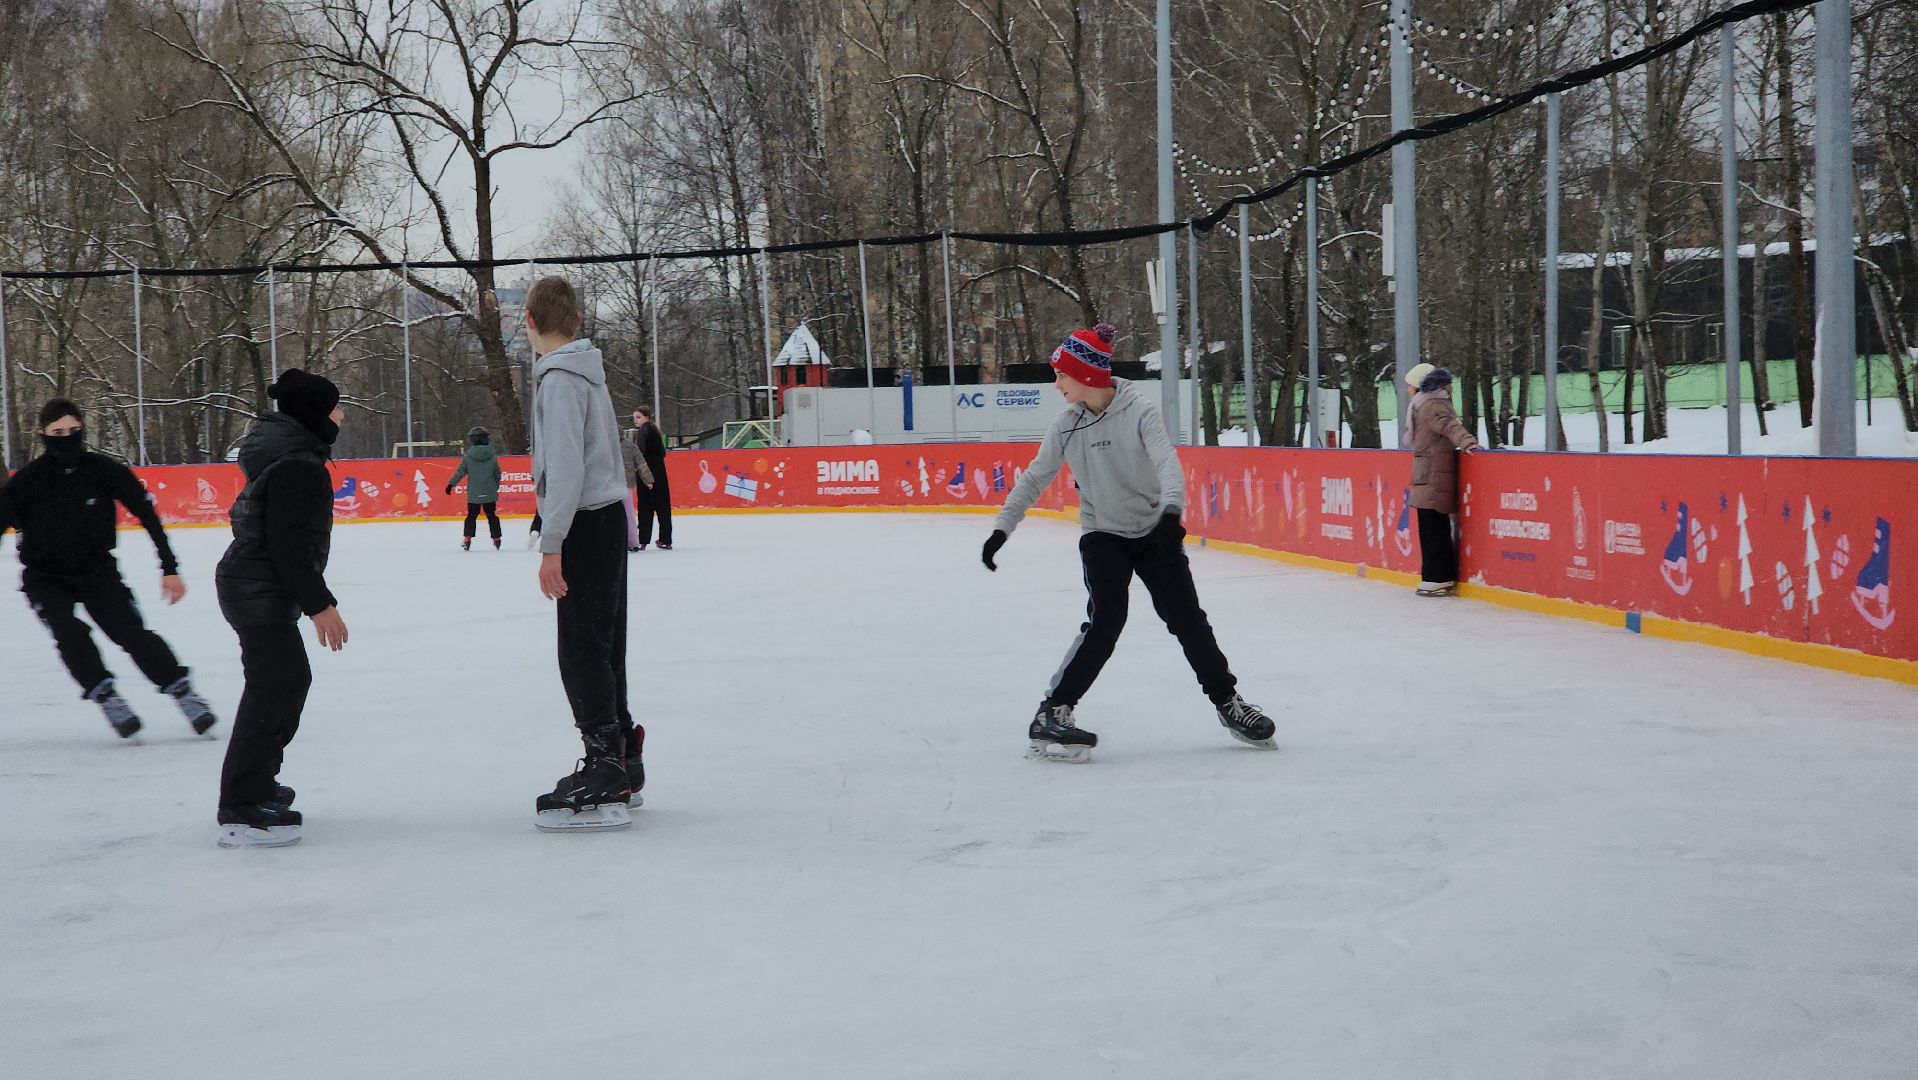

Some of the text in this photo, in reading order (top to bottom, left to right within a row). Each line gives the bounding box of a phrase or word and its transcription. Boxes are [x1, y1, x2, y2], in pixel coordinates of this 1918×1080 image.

[996, 389, 1040, 397] ЛЕДОВЫЙ
[996, 397, 1041, 406] СЕРВИС
[816, 459, 880, 482] ЗИМА
[1321, 476, 1353, 516] ЗИМА
